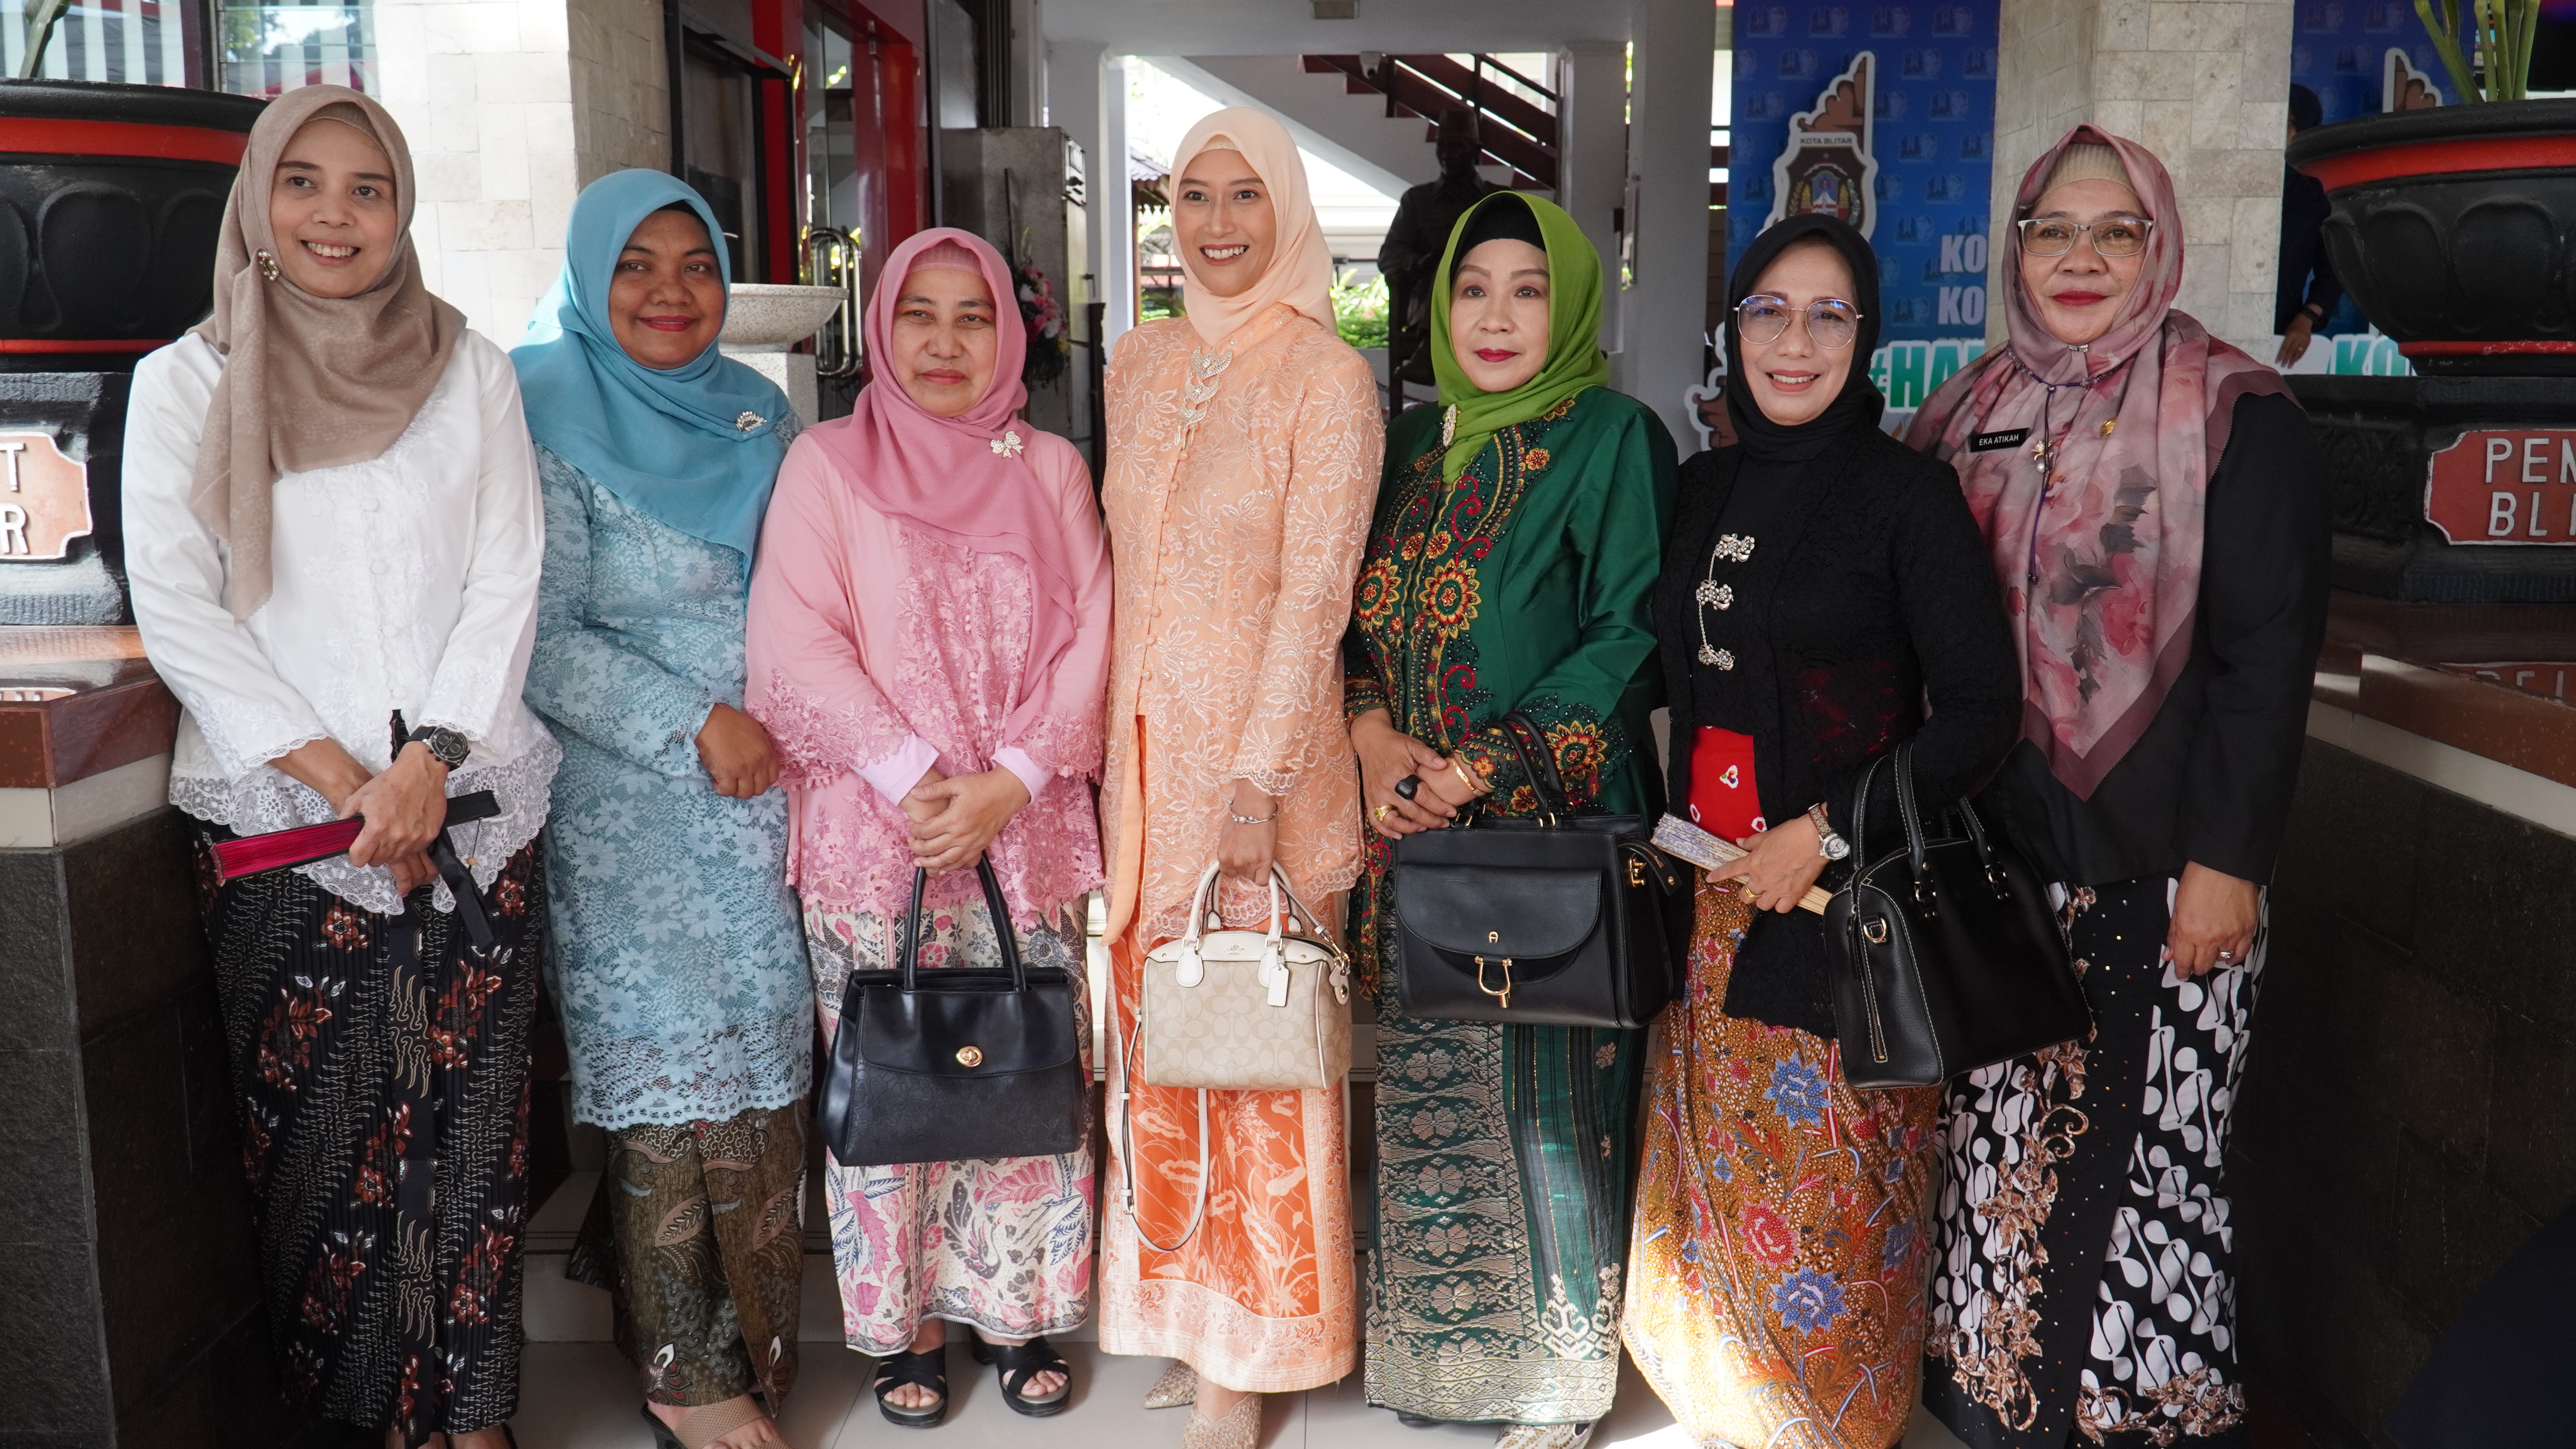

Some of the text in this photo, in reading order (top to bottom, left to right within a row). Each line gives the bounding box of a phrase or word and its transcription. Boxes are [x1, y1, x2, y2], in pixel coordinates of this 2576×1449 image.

[1940, 234, 1987, 273] KO
[1938, 286, 1985, 325] KO
[1979, 433, 2019, 446] EKA ATIKAH
